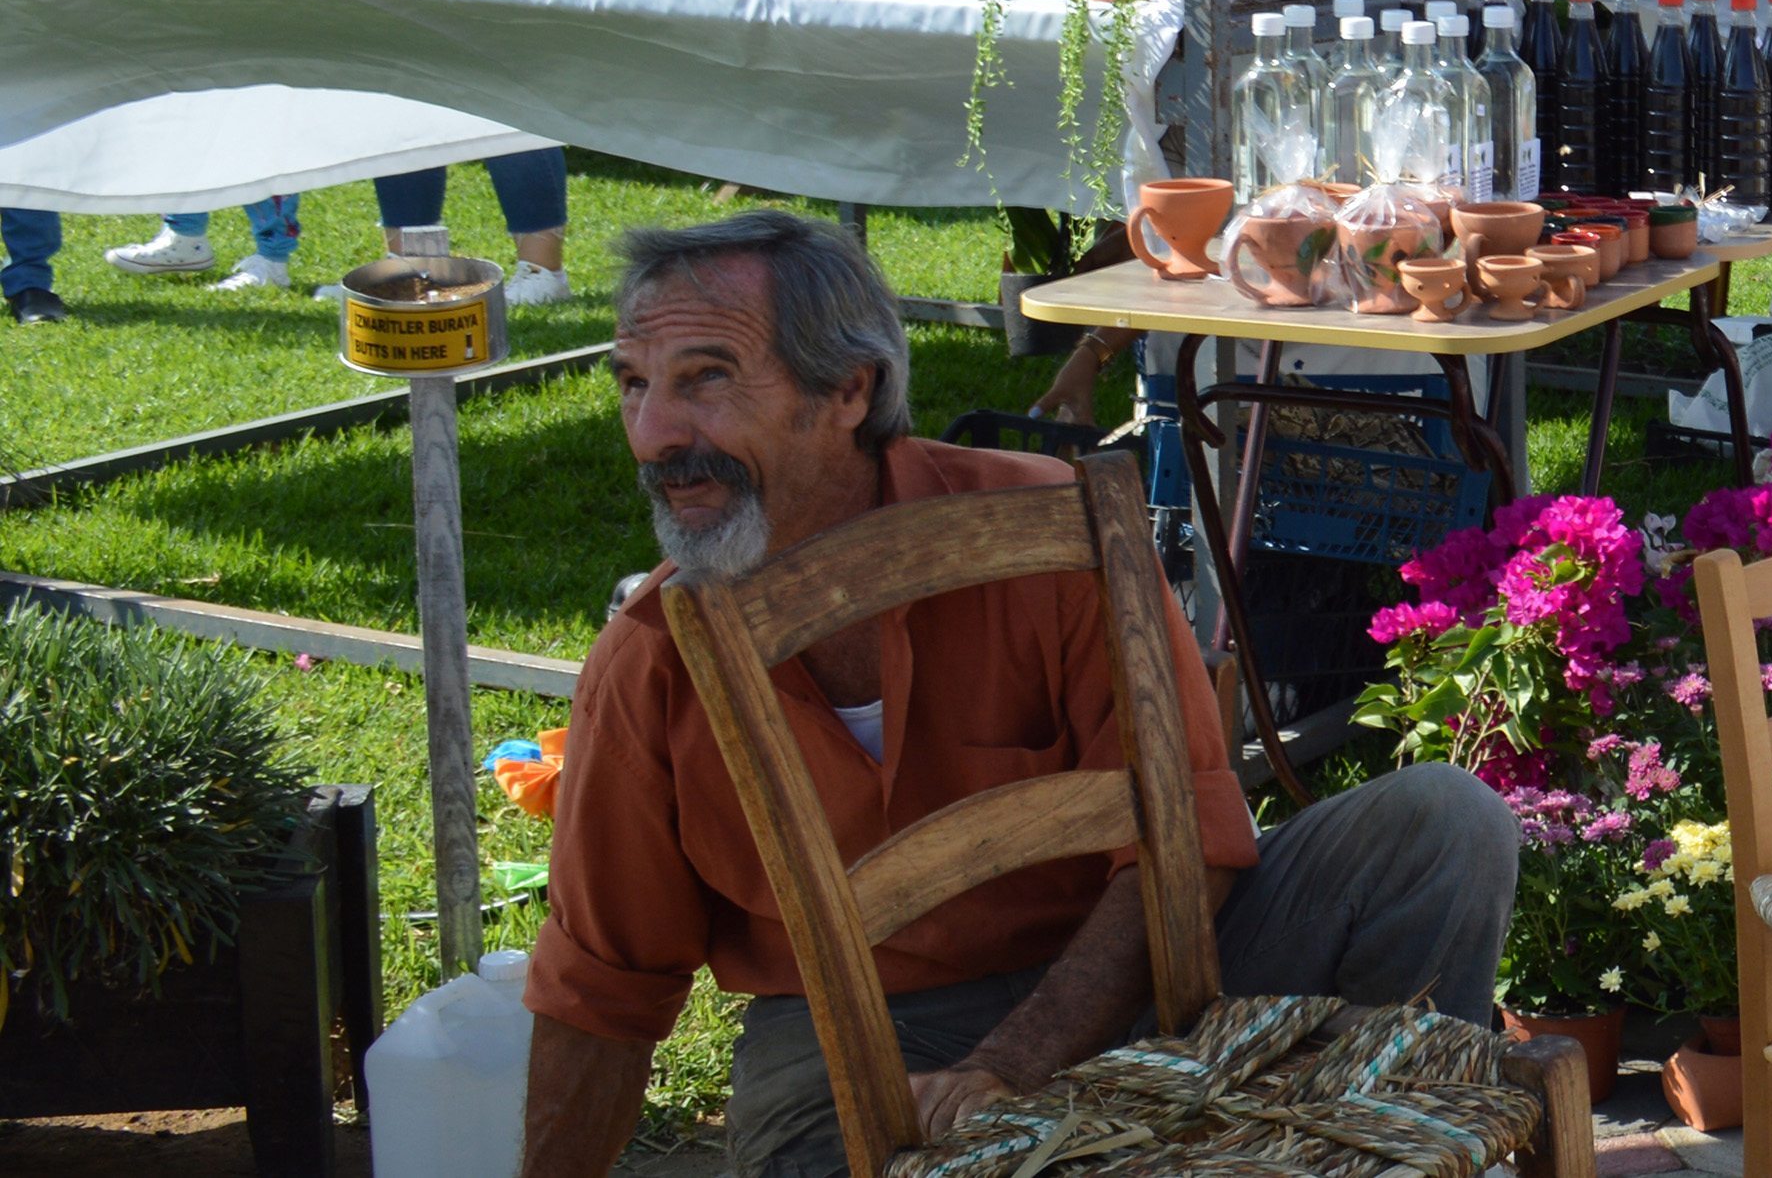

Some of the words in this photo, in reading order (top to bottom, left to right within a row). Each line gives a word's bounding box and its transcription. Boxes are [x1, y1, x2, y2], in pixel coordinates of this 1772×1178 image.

[429, 314, 478, 333] BURAYA
[354, 339, 389, 360] BUTTS
[393, 346, 407, 360] IN
[410, 345, 448, 360] HERE
